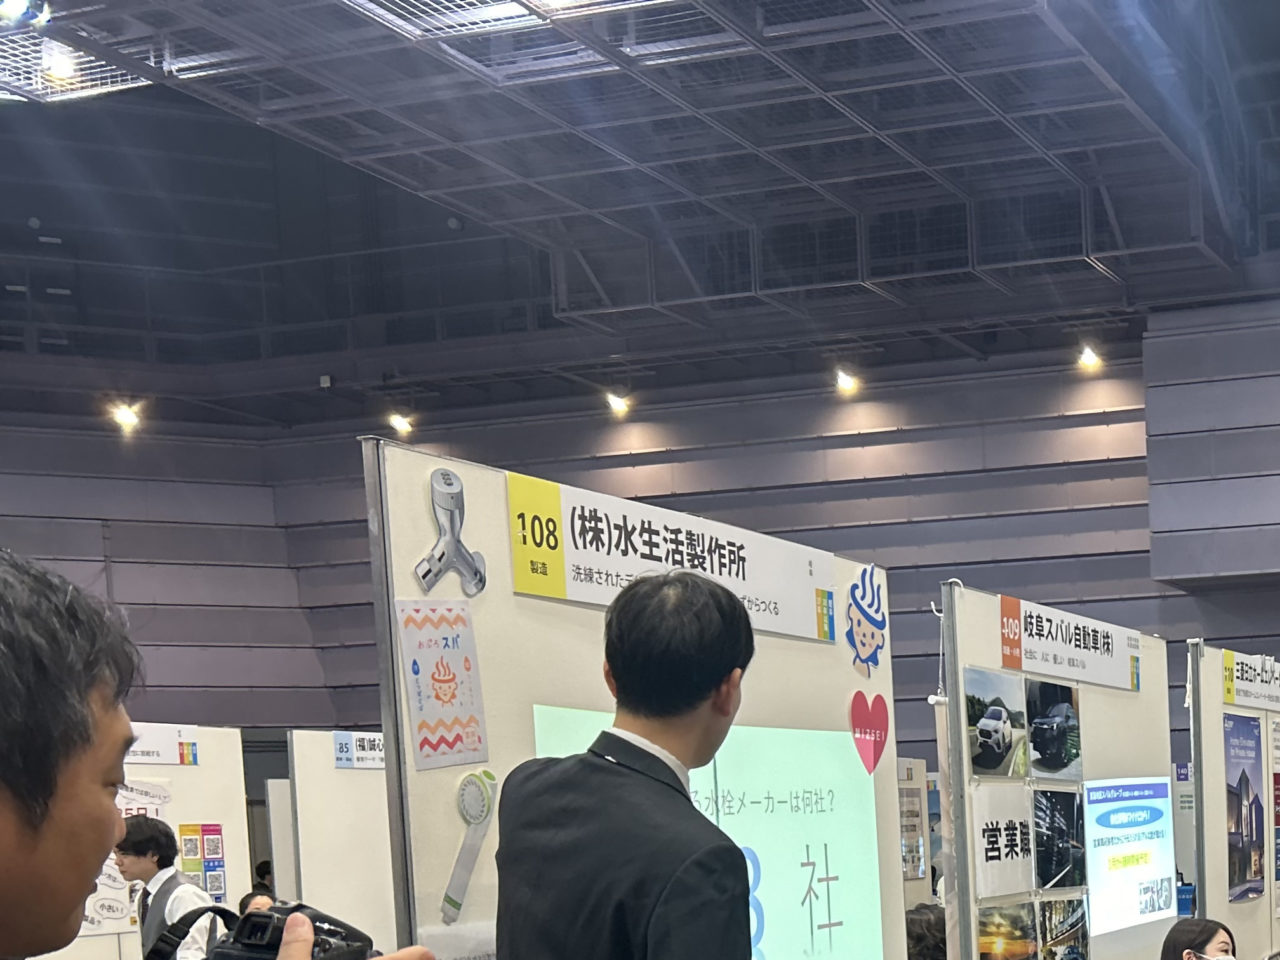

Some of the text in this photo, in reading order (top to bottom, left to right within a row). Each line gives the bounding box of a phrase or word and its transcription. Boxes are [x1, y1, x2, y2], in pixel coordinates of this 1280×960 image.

[517, 512, 559, 551] 108
[570, 505, 747, 581] (株)水生活製作所
[529, 560, 549, 577] 製造
[1002, 616, 1021, 641] 109
[1024, 609, 1114, 658] 岐阜スバル自動車(株)
[982, 819, 1032, 863] 営業職
[800, 842, 844, 953] 社
